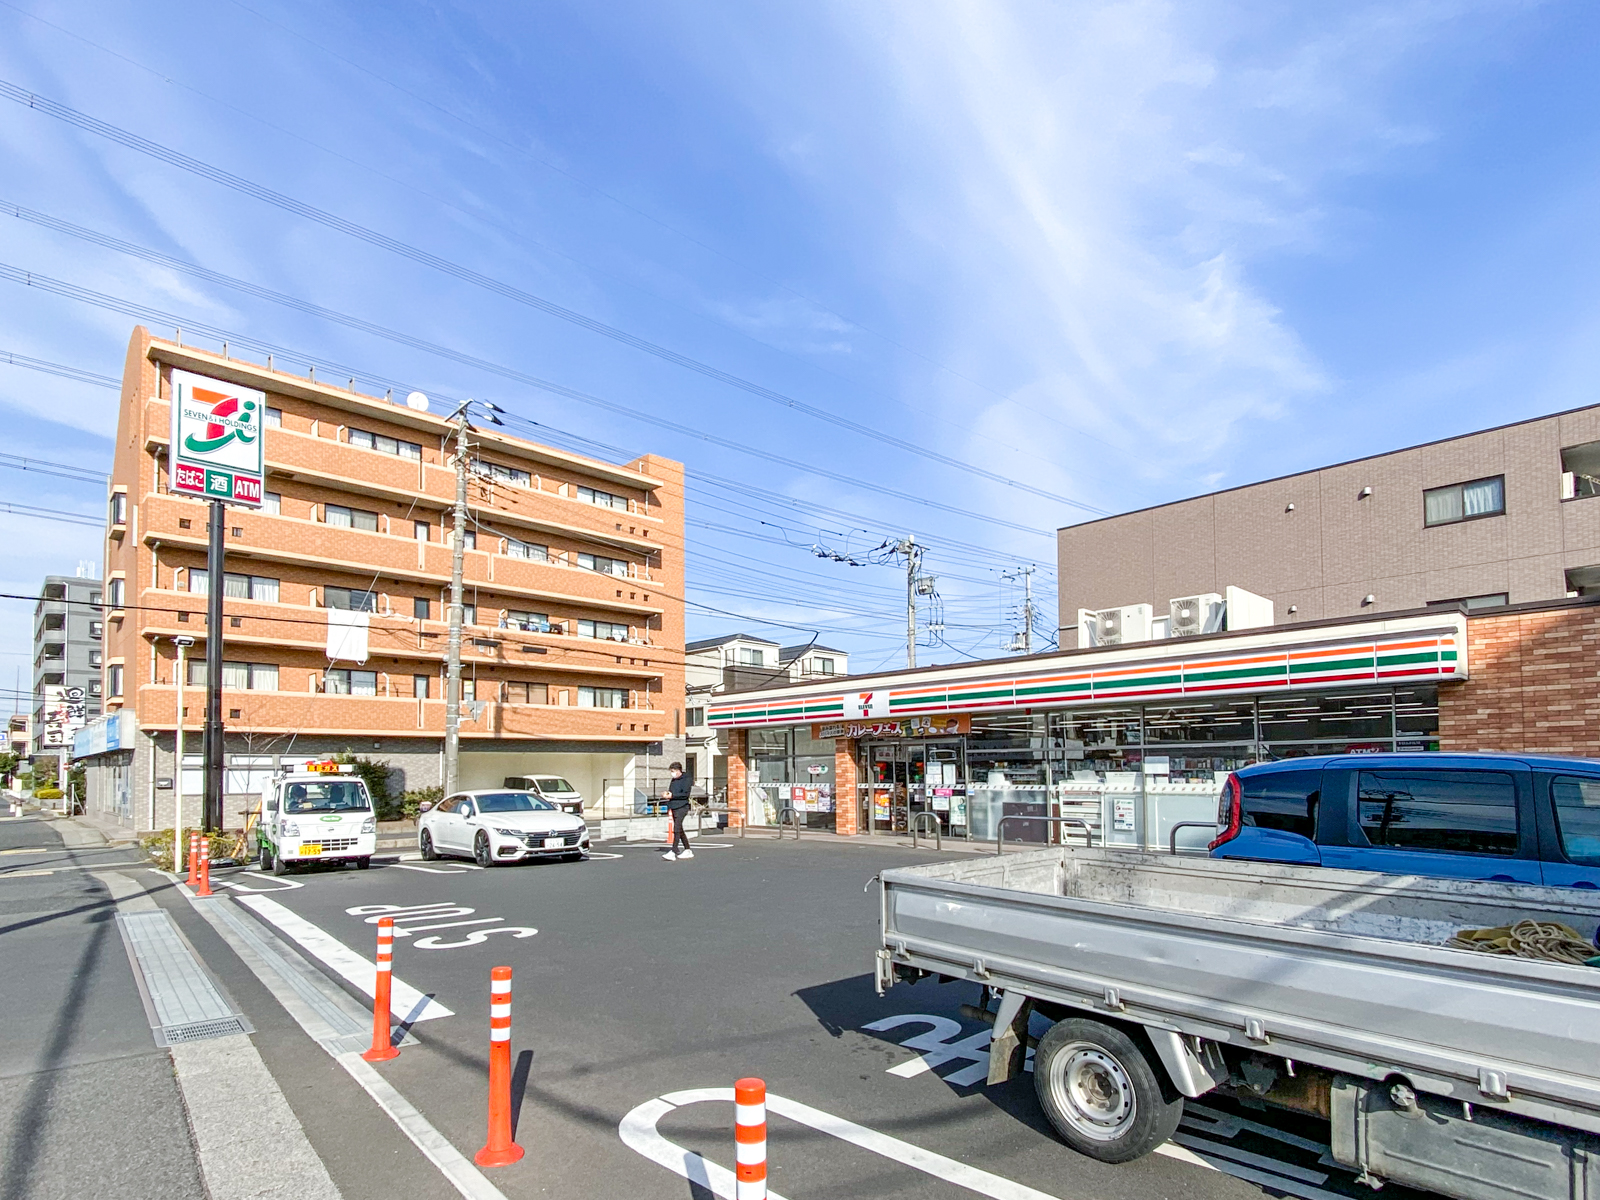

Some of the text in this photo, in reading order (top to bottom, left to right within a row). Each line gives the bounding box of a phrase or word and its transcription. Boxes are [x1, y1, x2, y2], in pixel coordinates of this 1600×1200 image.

[219, 417, 257, 432] HOLDINGS
[176, 467, 260, 499] たばこ 酒 ATM
[846, 721, 903, 739] カレーフェス
[345, 902, 539, 949] STOP
